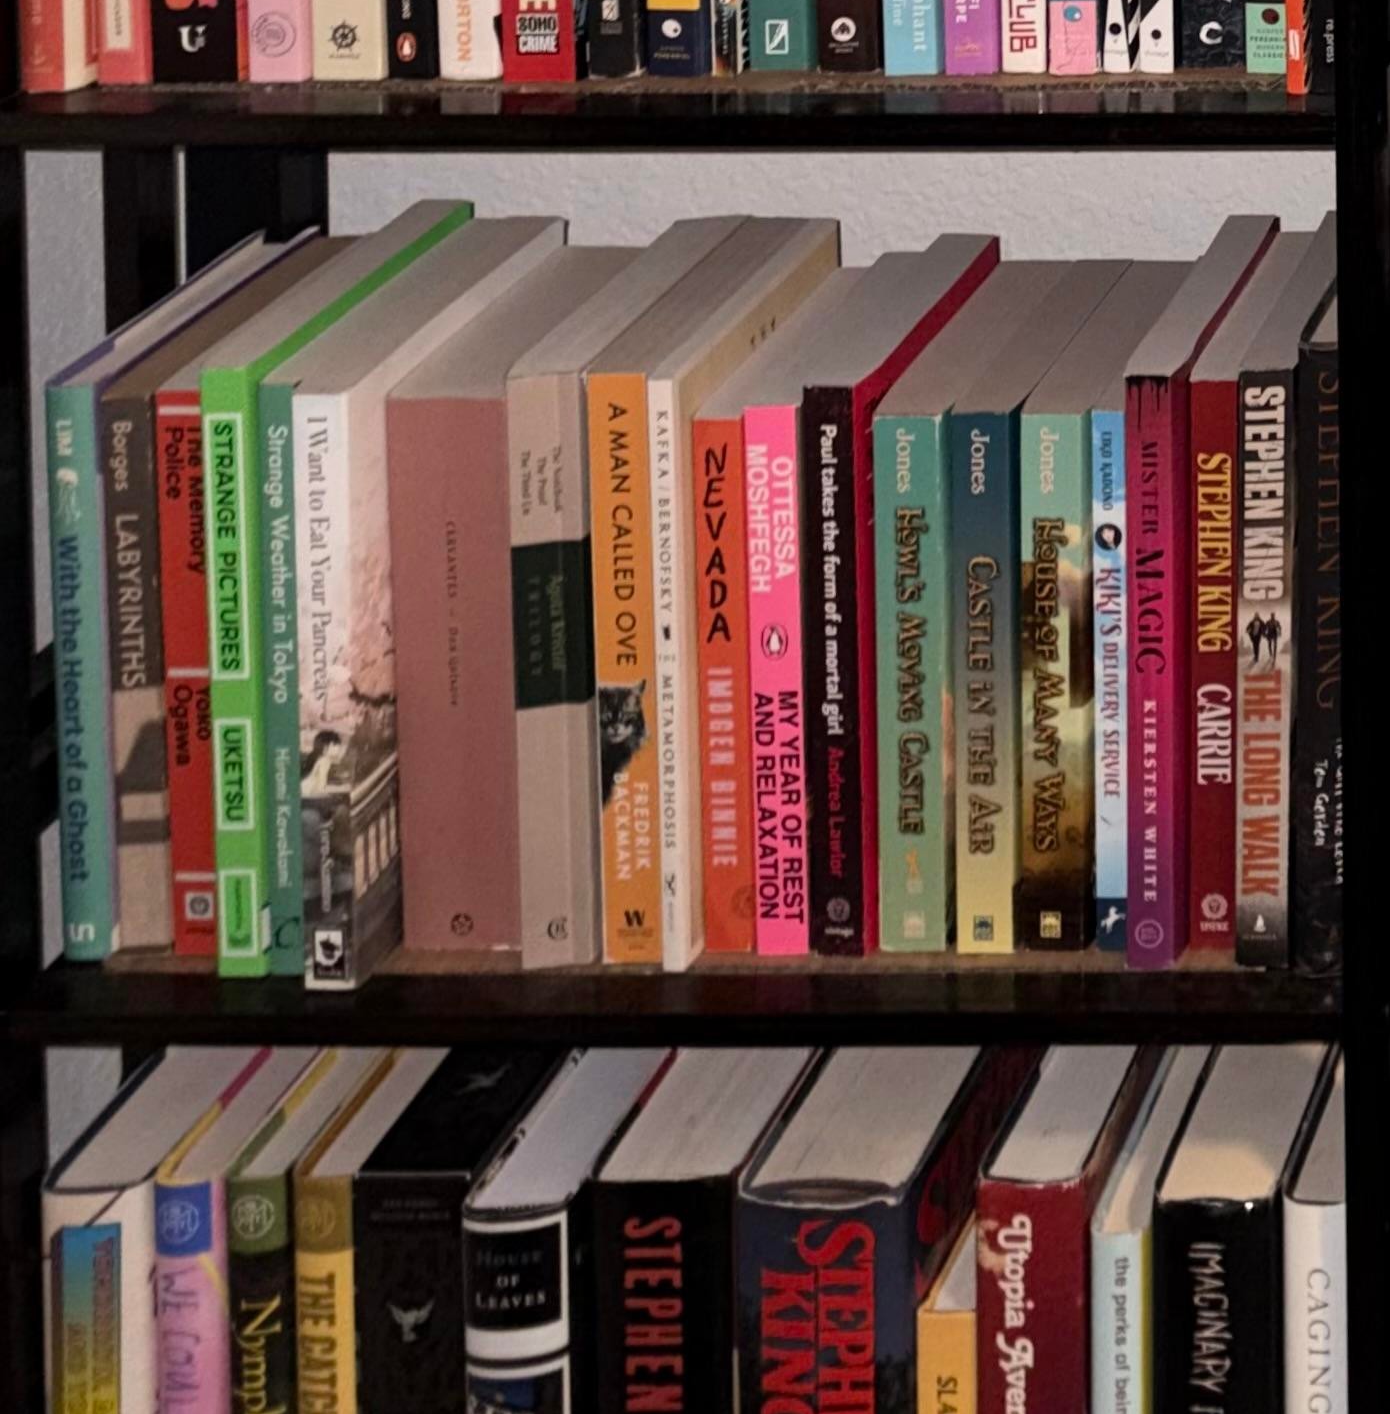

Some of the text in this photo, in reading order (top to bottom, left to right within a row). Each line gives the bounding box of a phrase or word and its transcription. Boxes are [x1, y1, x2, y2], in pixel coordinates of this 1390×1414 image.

[518, 34, 558, 54] CRIME
[213, 423, 243, 673] STRANGE PICTURES
[608, 403, 637, 665] A MAN CALLED OVE
[704, 445, 730, 642] NEVADA
[1244, 386, 1285, 599] STEPHEN KING
[115, 514, 145, 688] LABYRINTHS
[223, 728, 244, 822] UKETSU
[663, 676, 676, 849] METAMORPHOSIS
[1242, 671, 1282, 896] THE LONG WALK
[624, 1217, 684, 1411] STEPHEN
[1308, 1268, 1331, 1414] CAGING
